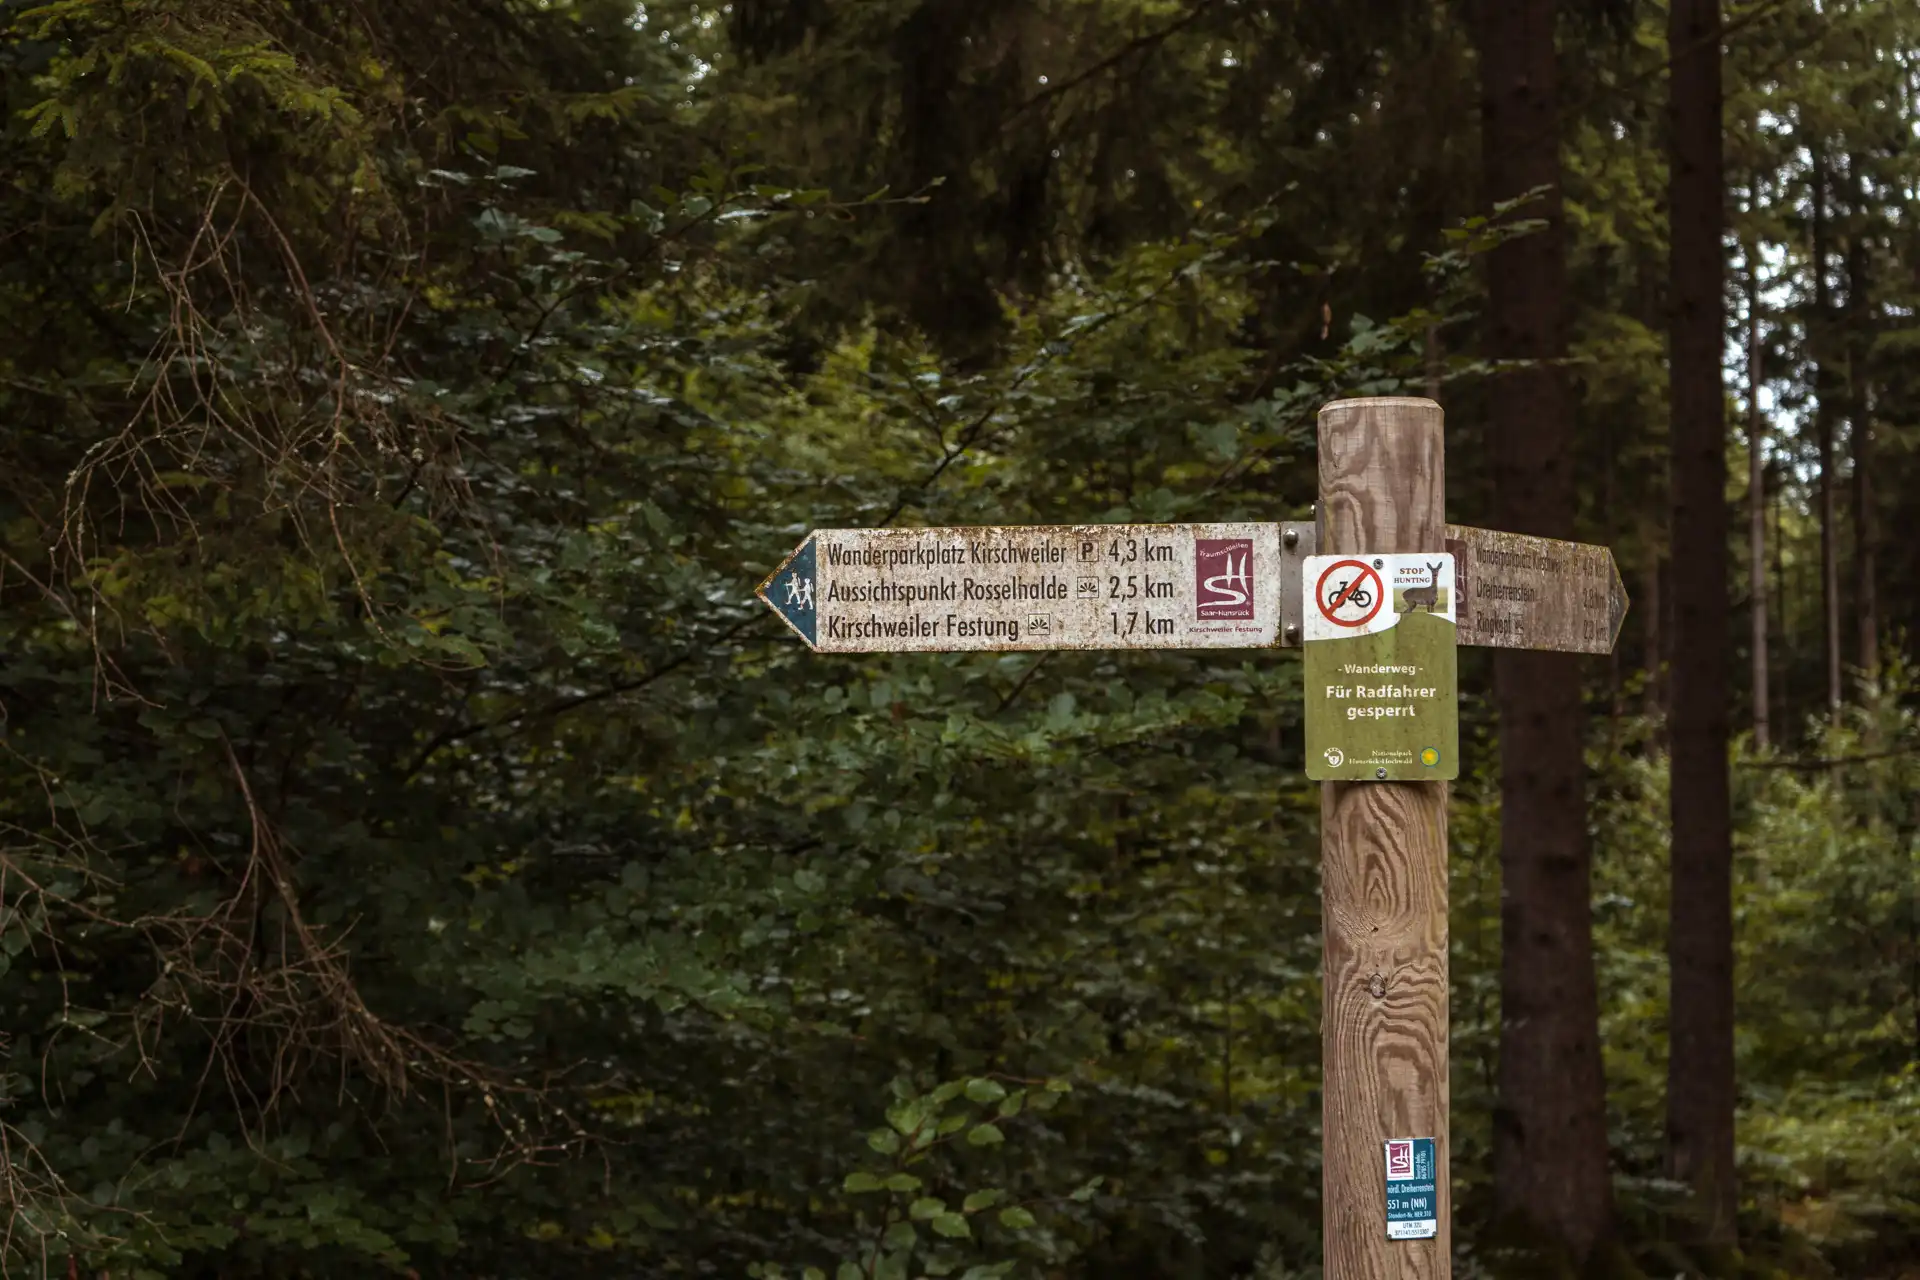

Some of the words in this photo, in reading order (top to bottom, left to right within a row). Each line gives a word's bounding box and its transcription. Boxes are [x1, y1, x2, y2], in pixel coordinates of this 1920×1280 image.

[827, 541, 966, 570] Wanderparkplatz
[971, 539, 1067, 564] Kirschweiler
[1108, 539, 1138, 566] 4,3
[1145, 538, 1173, 562] km
[1400, 567, 1425, 575] STOP
[827, 577, 957, 605] Aussichtspunkt
[963, 576, 1068, 600] Rosselhalde
[1109, 575, 1138, 602] 2,5
[1145, 574, 1174, 598] km
[1476, 576, 1535, 602] Dreiherrenstein
[828, 614, 940, 638] Kirschweiler
[947, 614, 1019, 642] Festung
[1111, 612, 1138, 639] 1,7
[1145, 611, 1174, 634] km
[1235, 626, 1263, 634] Festung
[1476, 611, 1511, 638] Ringkopf
[1344, 664, 1416, 675] Wanderweg
[1326, 686, 1352, 698] Für
[1356, 685, 1436, 698] Radfahrer
[1347, 705, 1416, 720] gesperrt
[1387, 1199, 1400, 1210] 551
[1402, 1201, 1409, 1209] m
[1410, 1197, 1427, 1210] (NN)
